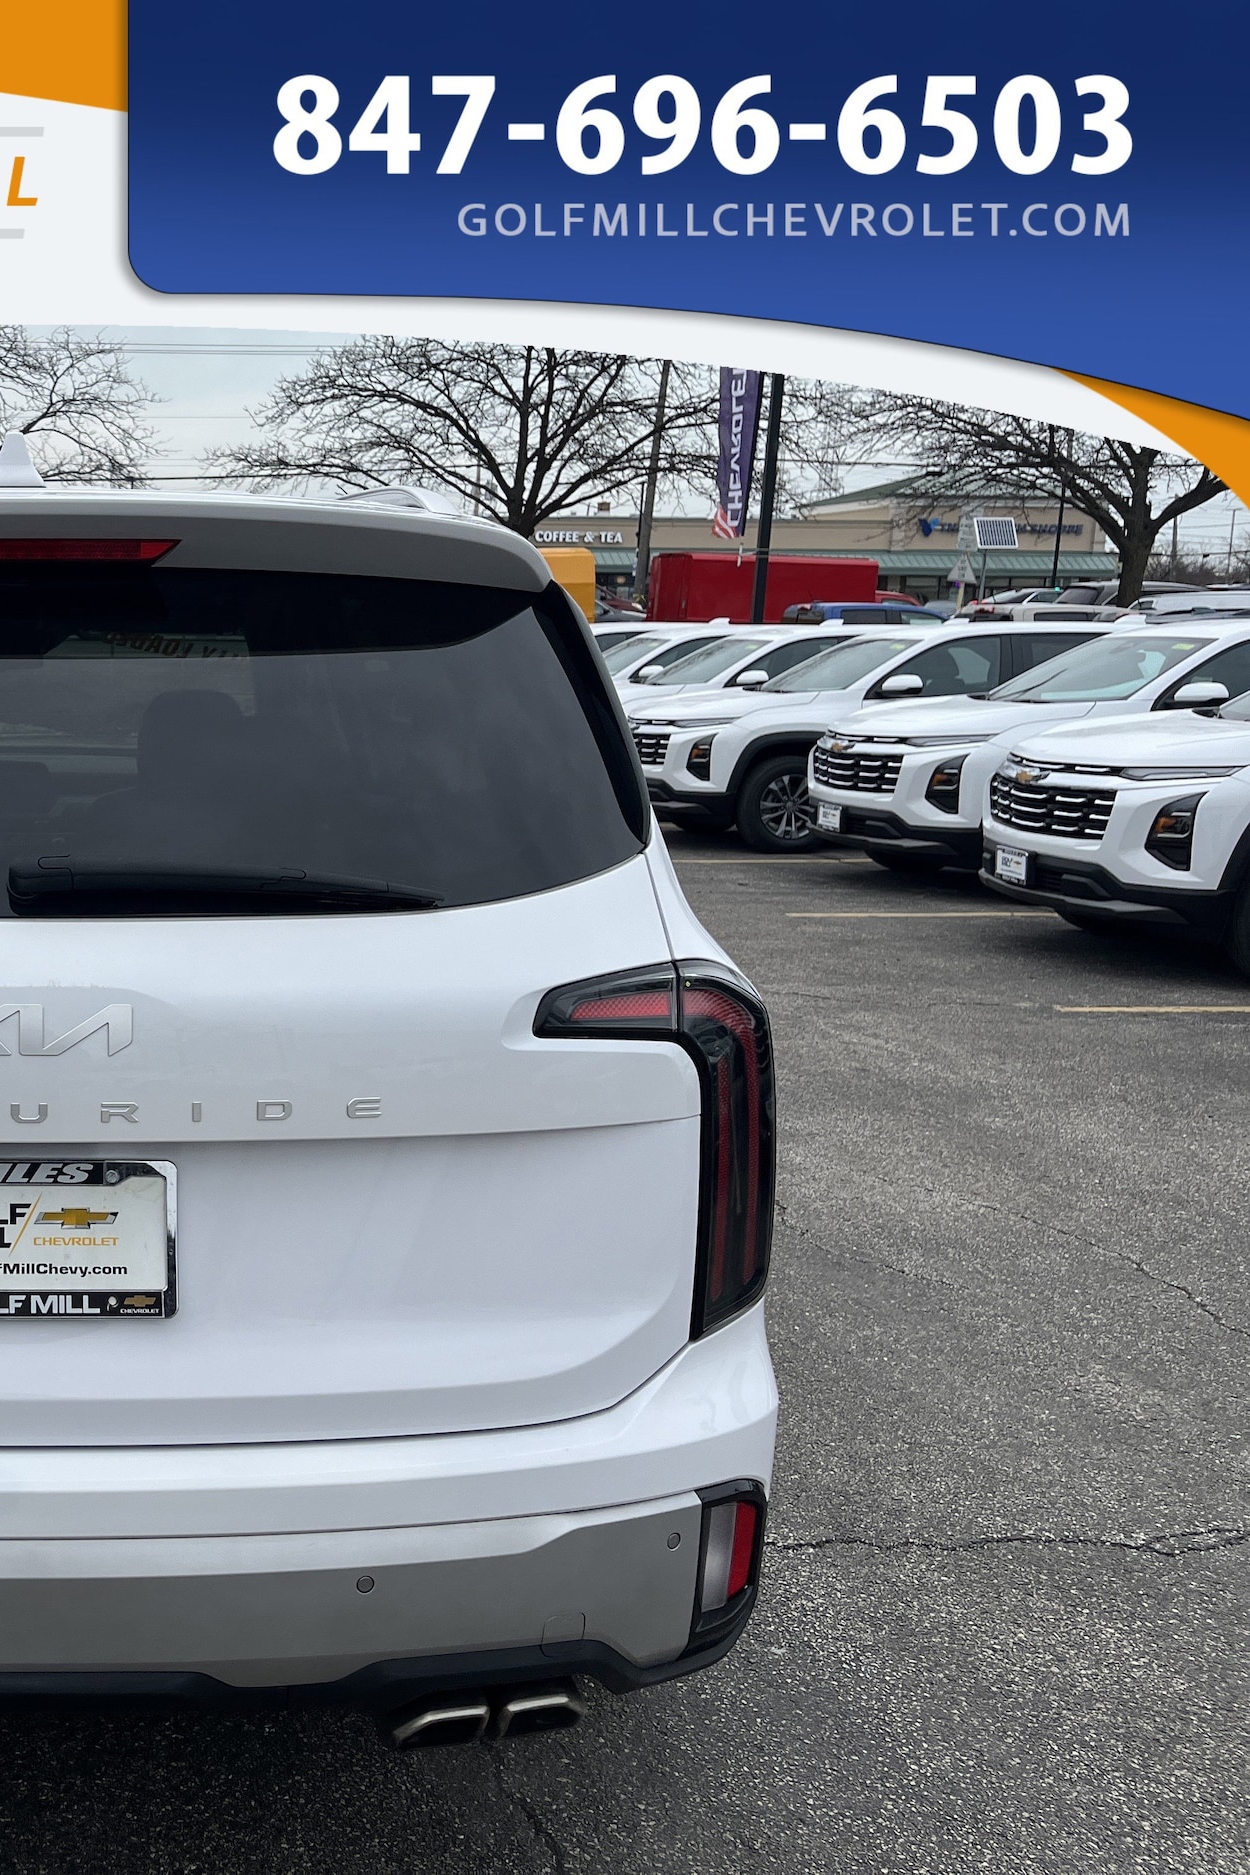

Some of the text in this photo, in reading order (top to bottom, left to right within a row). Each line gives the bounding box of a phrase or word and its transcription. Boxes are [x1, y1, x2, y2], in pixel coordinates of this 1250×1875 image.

[535, 530, 623, 543] COFFEE & TEA
[33, 1236, 120, 1246] CHEVROLET
[30, 1295, 100, 1314] MILL
